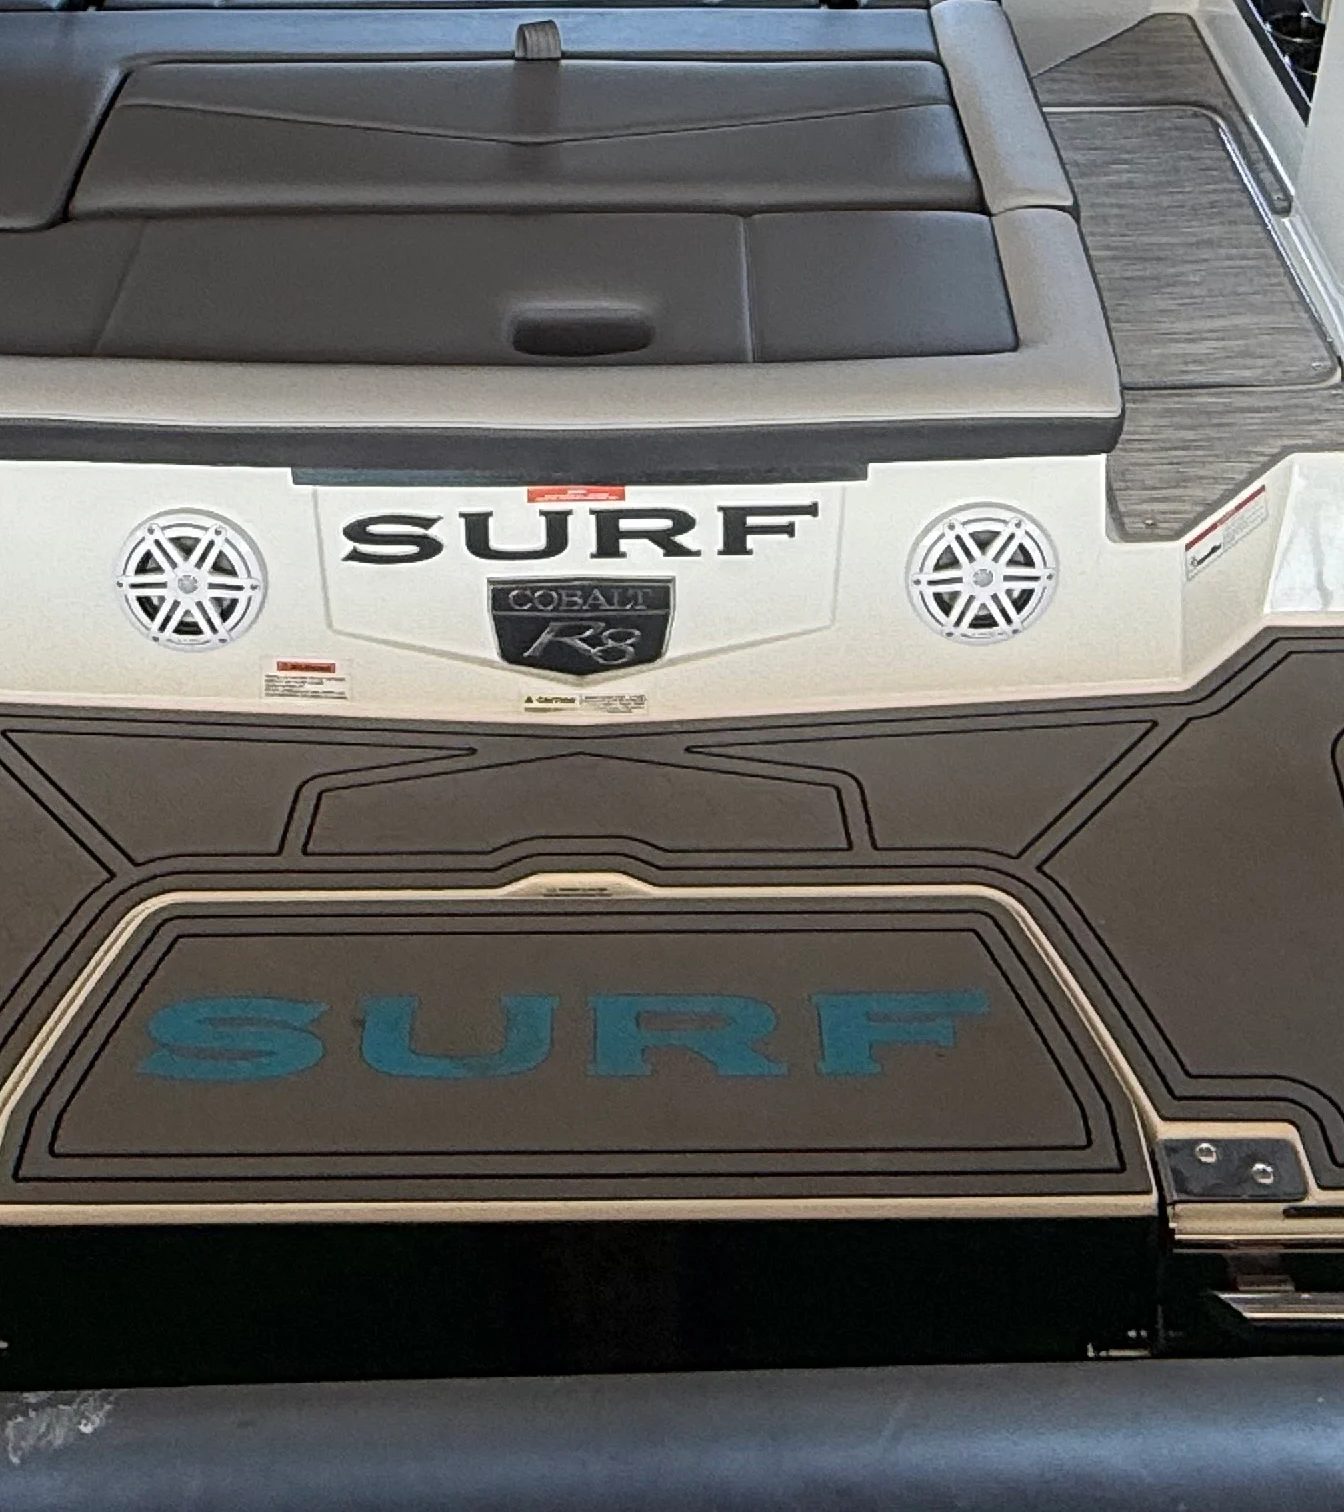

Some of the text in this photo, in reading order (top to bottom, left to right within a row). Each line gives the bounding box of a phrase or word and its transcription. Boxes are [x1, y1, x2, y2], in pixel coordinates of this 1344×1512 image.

[341, 502, 819, 564] SURF
[507, 588, 653, 611] COBALT
[522, 619, 643, 666] R8
[136, 988, 990, 1080] SURF
